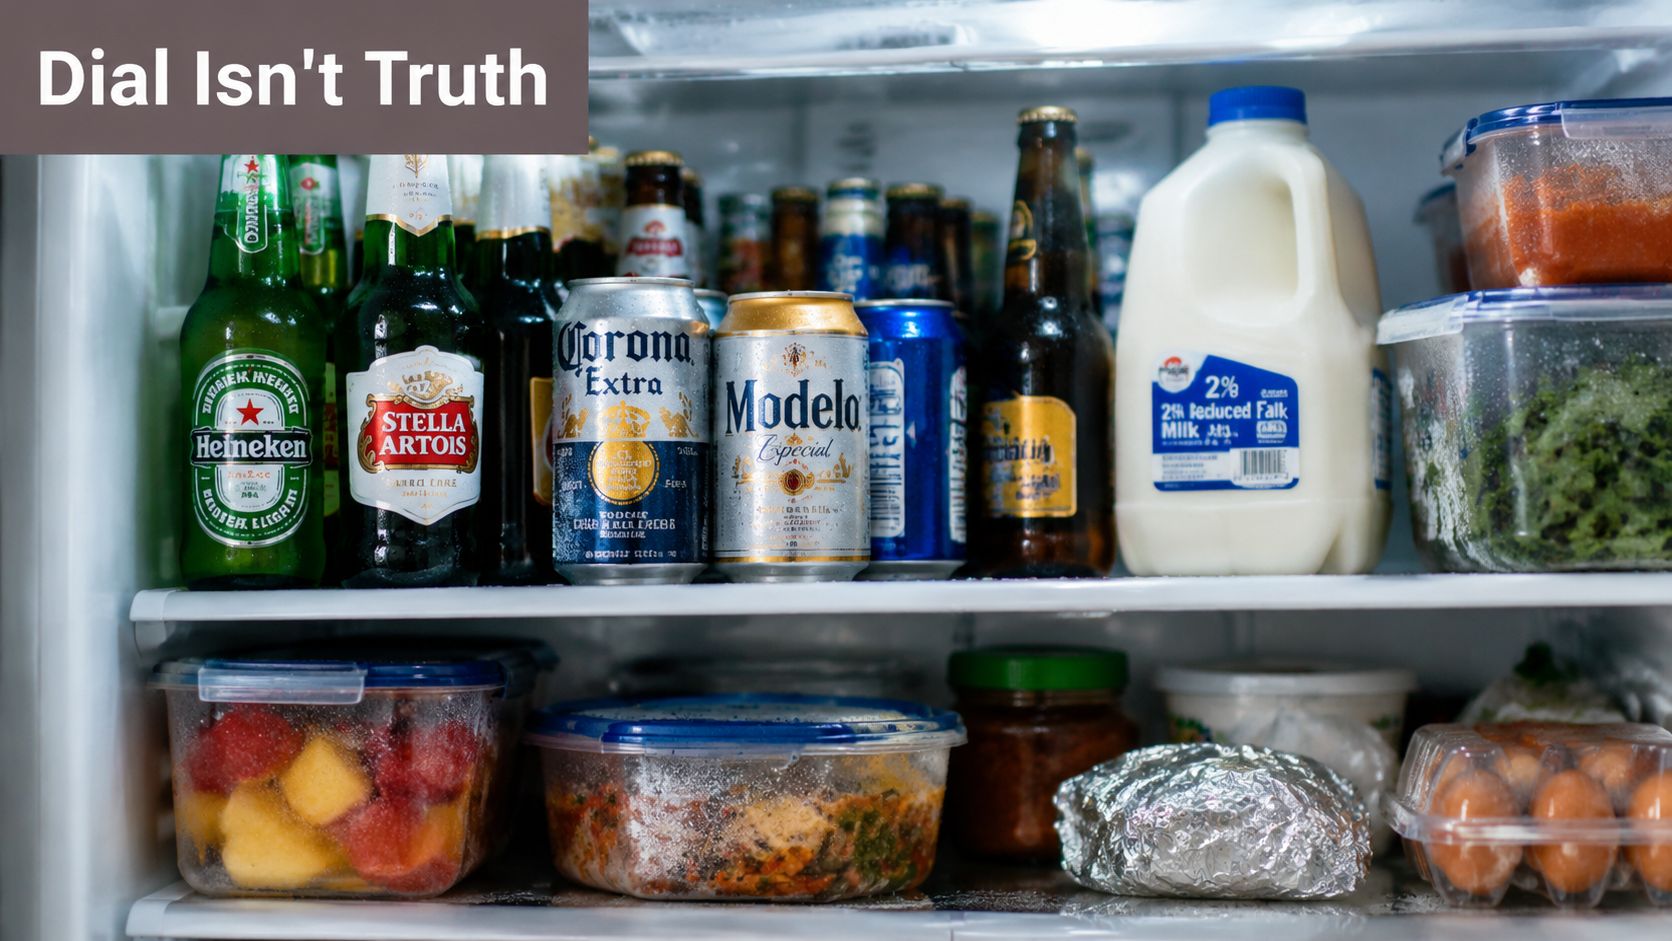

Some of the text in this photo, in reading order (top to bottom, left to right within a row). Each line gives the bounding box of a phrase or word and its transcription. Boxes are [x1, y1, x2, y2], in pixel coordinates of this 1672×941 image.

[557, 321, 693, 378] Corona
[586, 365, 663, 396] Extra
[1205, 375, 1239, 399] 2%
[725, 379, 861, 436] Modelo
[382, 412, 466, 432] STELLA
[1161, 421, 1200, 439] Milk
[196, 434, 307, 459] Heineken
[379, 435, 466, 455] ARTOIS
